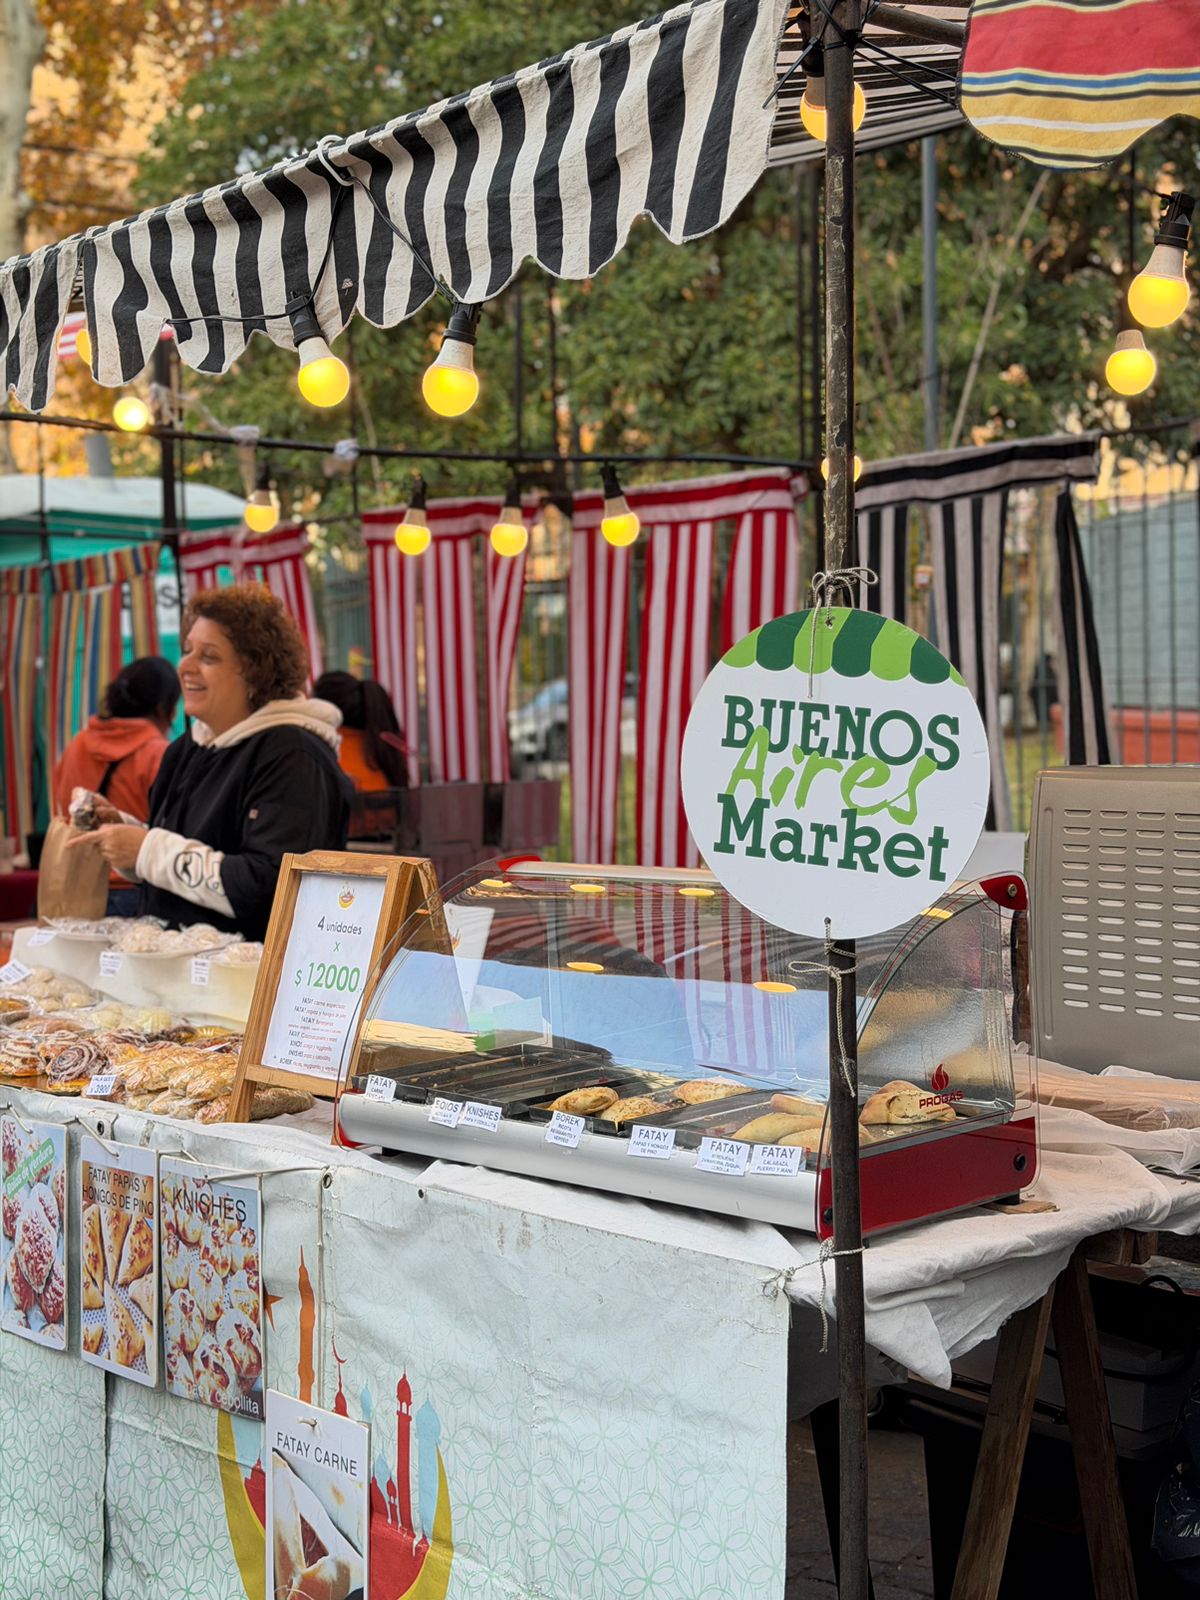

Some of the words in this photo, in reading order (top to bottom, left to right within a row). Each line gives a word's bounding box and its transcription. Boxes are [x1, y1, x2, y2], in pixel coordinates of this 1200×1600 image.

[720, 694, 960, 771] BUENOS
[725, 725, 938, 826] Aires
[713, 793, 950, 882] Market
[317, 915, 326, 931] 4
[326, 921, 363, 935] unidades
[294, 968, 303, 987] $
[307, 962, 361, 993] 12000
[369, 1075, 394, 1088] FATAY
[467, 1104, 500, 1121] KNISHES
[556, 1112, 580, 1126] BOREK
[638, 1129, 669, 1142] FATAY
[710, 1140, 743, 1156] FATAY
[761, 1146, 796, 1159] FATAY
[88, 1166, 112, 1185] FATAY
[113, 1171, 140, 1191] PAPAS
[141, 1178, 149, 1193] Y
[82, 1185, 117, 1207] HONGOS
[119, 1193, 131, 1210] DE
[133, 1196, 154, 1216] PINO
[172, 1187, 247, 1223] KNISHES
[215, 1391, 260, 1415] cebollita
[276, 1431, 311, 1458] FATAY
[314, 1446, 357, 1477] CARNE
